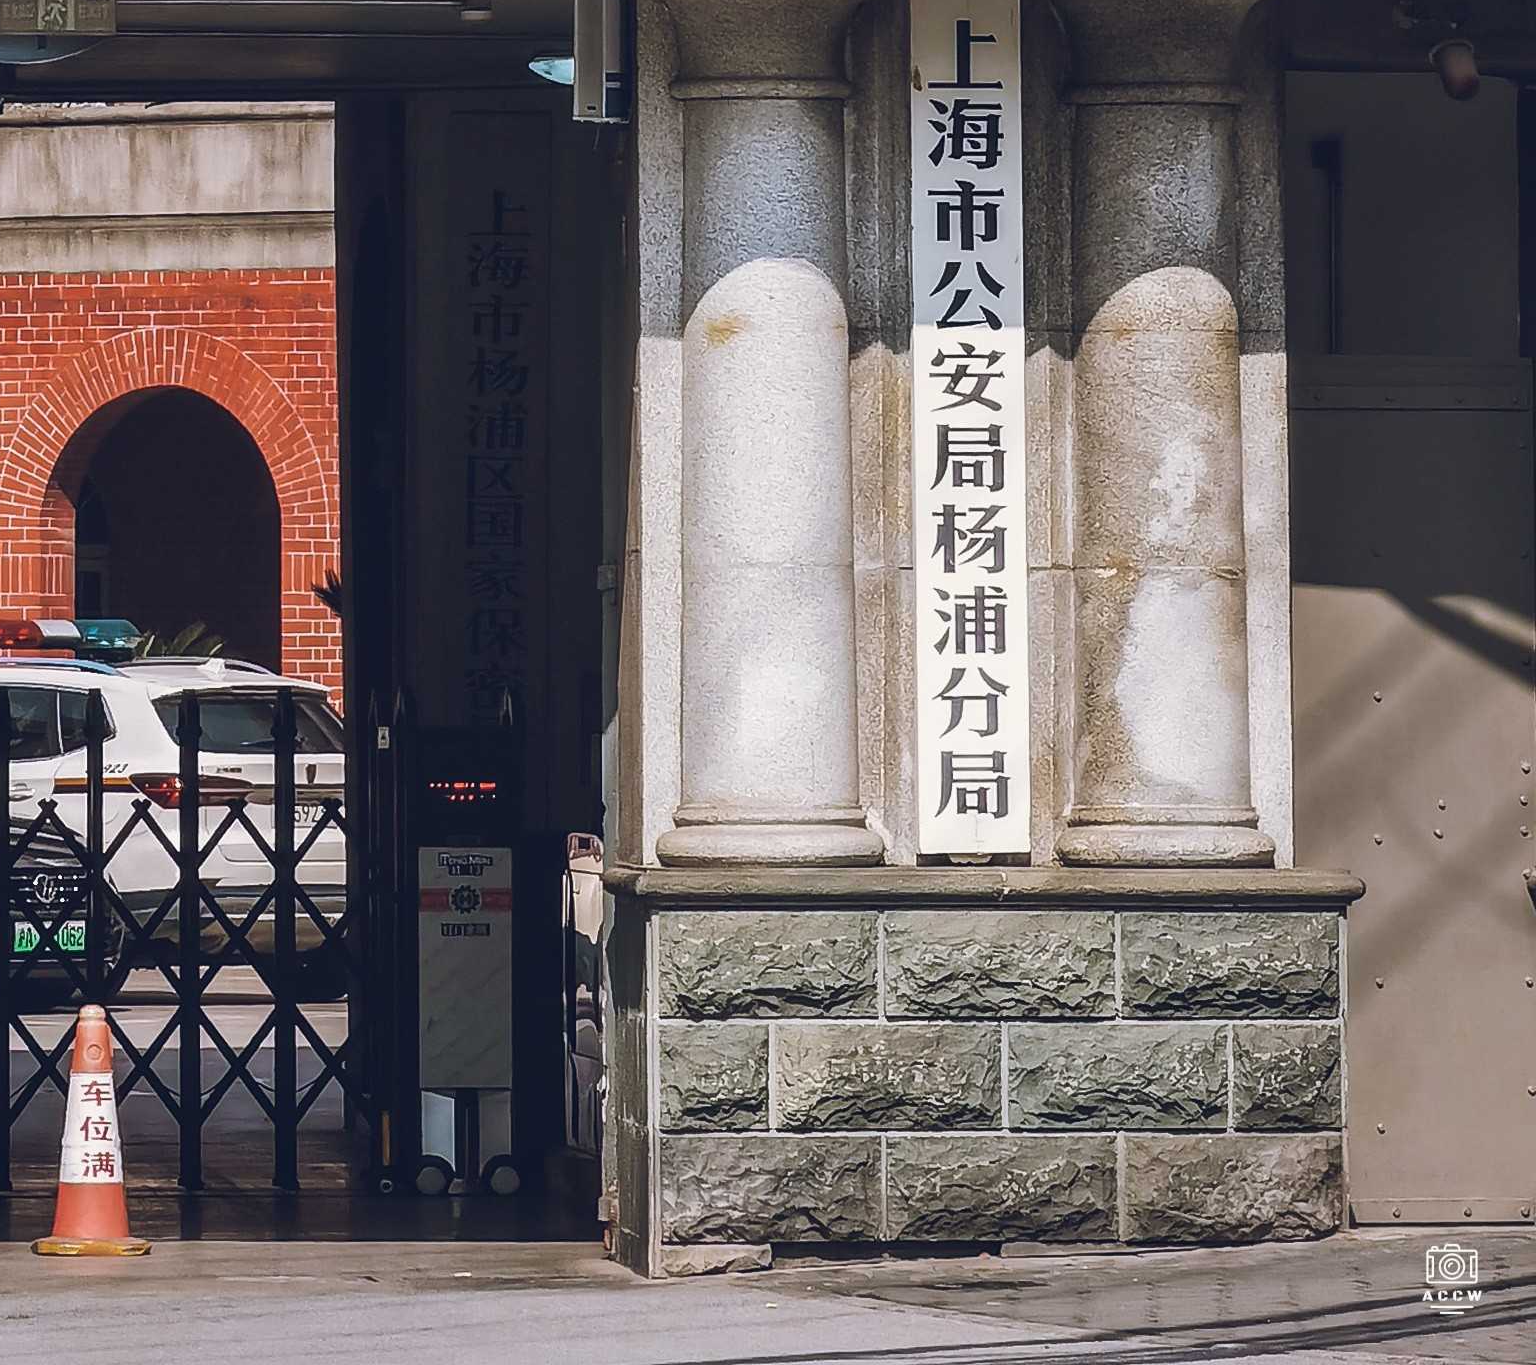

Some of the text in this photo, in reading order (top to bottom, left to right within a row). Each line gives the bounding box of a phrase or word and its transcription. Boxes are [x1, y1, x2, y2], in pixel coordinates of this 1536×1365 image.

[926, 19, 1009, 820] 上海市公安局杨浦分局
[80, 1080, 115, 1178] 车位满
